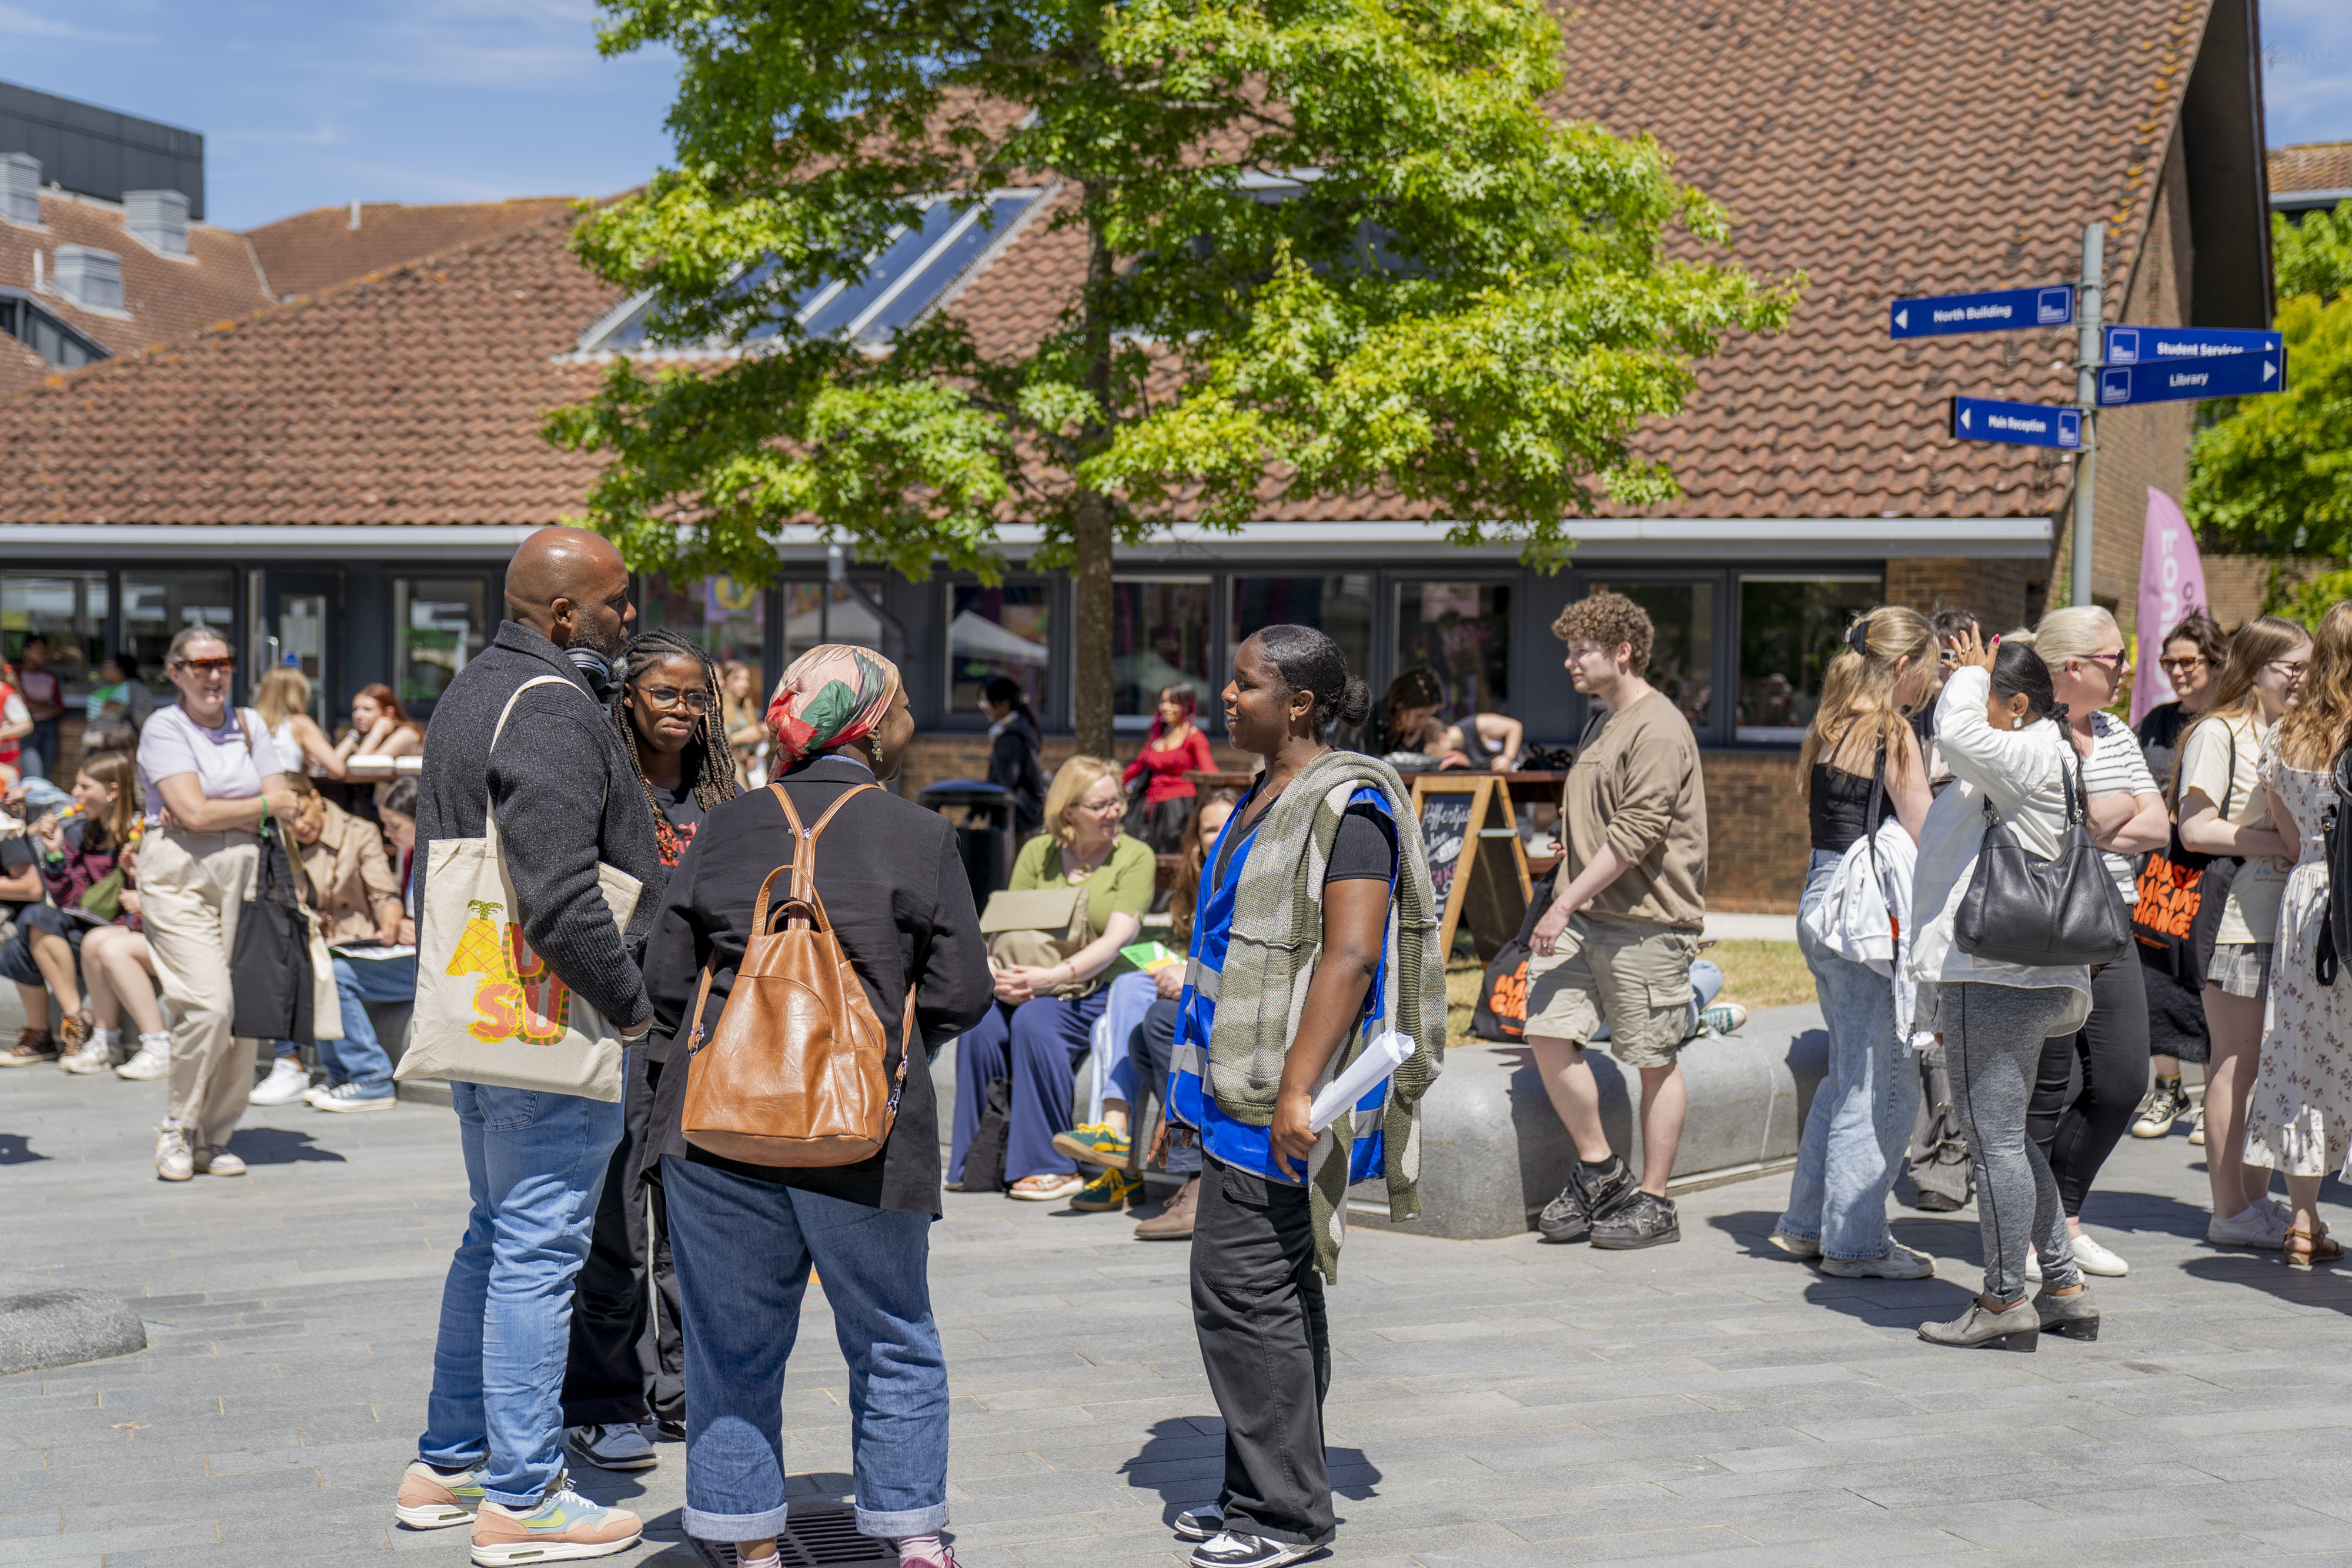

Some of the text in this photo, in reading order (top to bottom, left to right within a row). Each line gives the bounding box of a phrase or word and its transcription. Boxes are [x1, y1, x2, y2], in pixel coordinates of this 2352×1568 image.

[1933, 304, 2013, 323] North Building
[2156, 342, 2244, 356] Student Services
[2169, 372, 2209, 387] Library
[1988, 414, 2047, 433] Main Reception
[2145, 852, 2203, 890] BUSY
